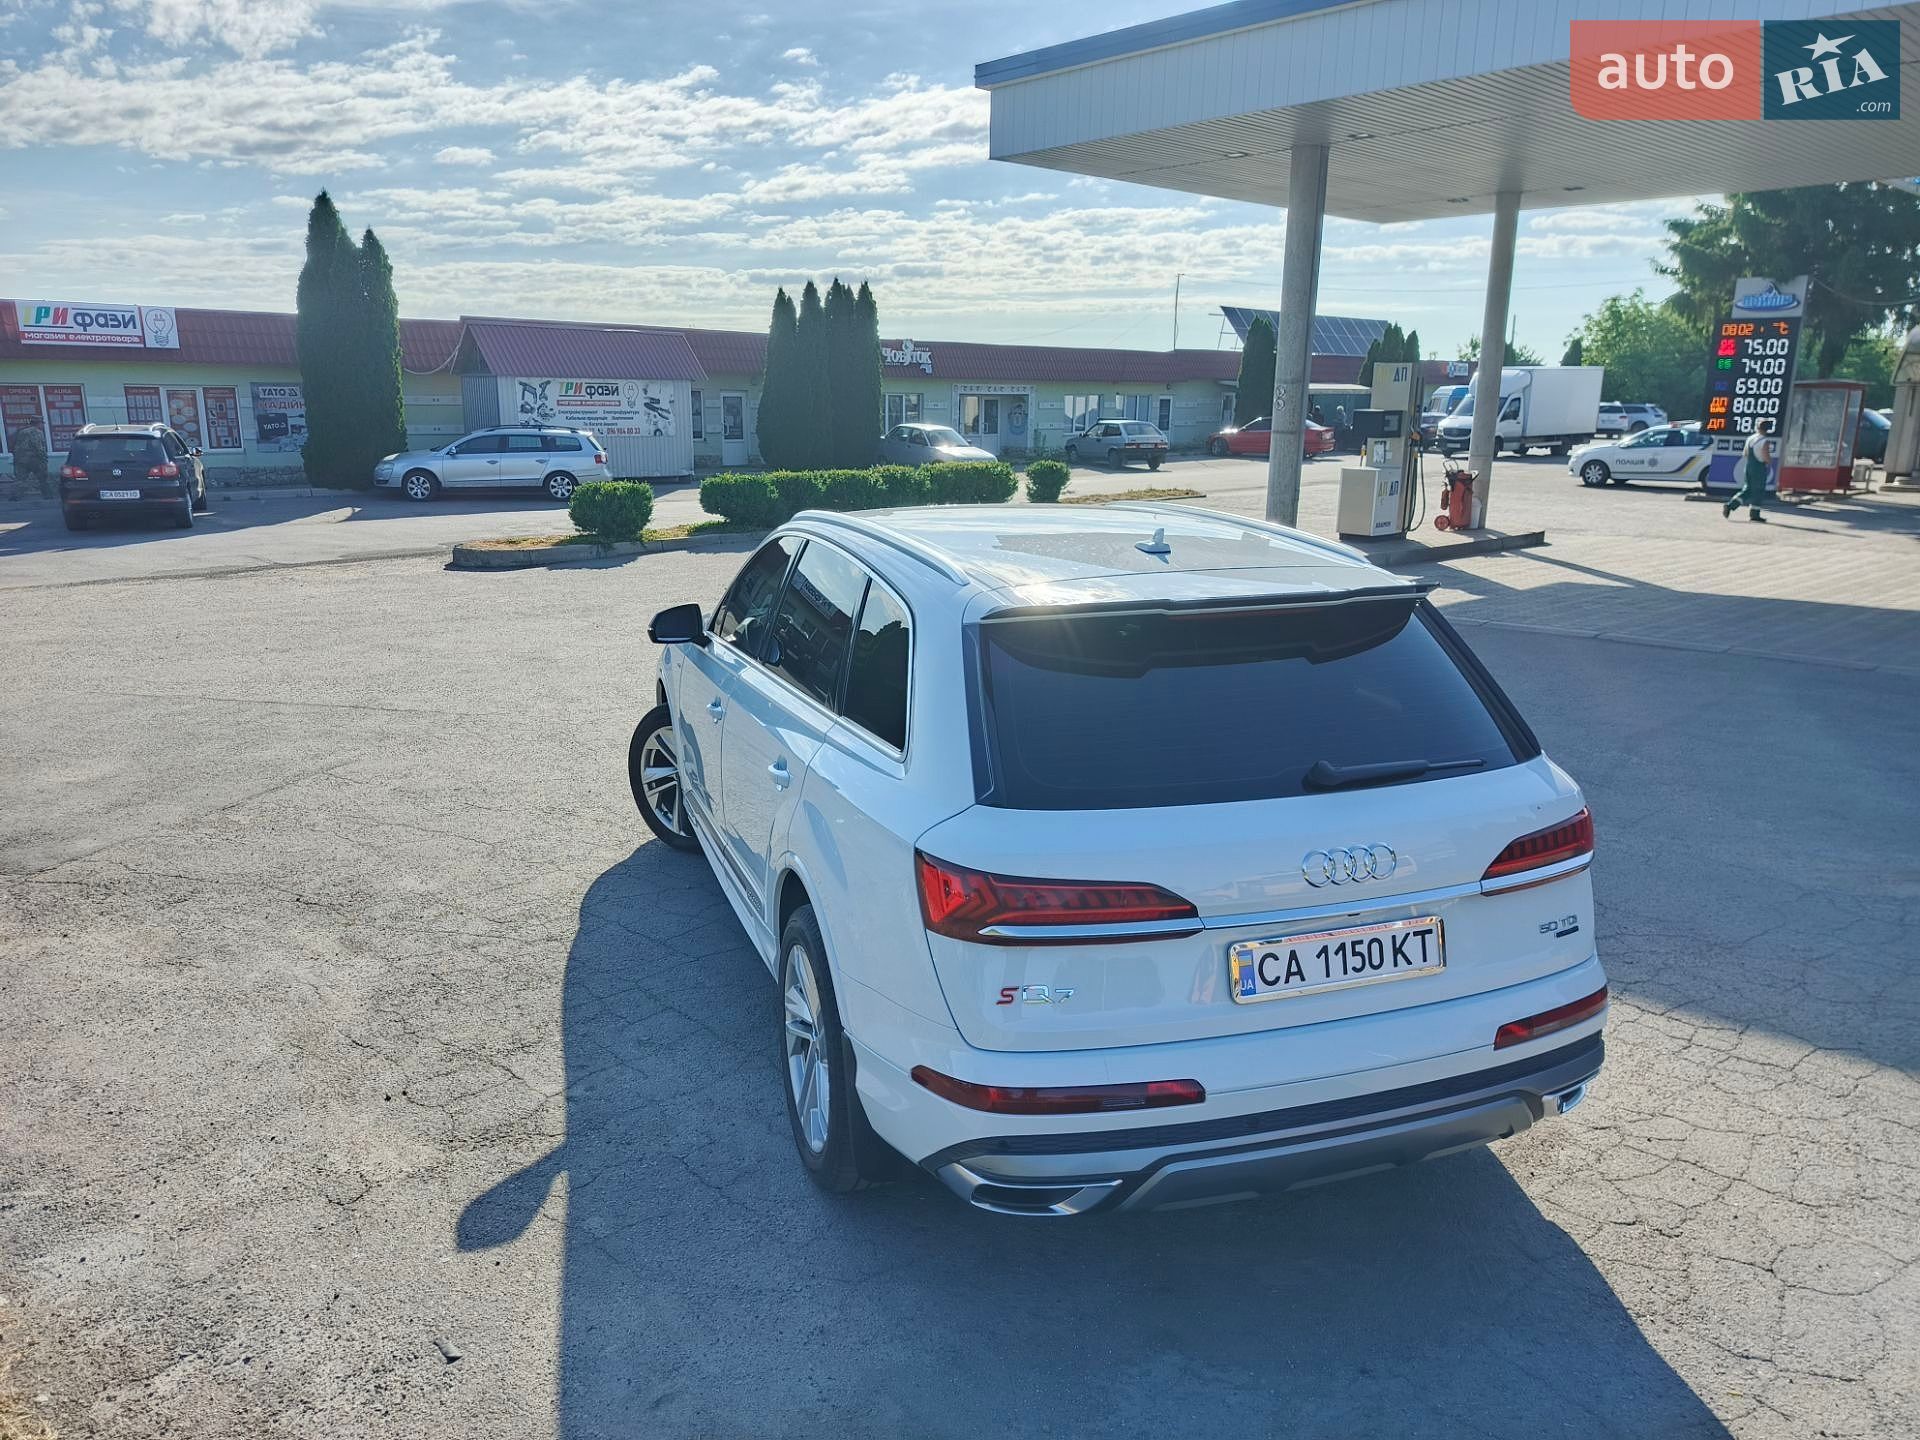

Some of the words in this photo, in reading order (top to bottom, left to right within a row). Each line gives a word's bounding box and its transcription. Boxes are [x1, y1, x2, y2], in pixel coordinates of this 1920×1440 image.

[73, 311, 137, 332] фази
[1744, 338, 1789, 356] 75.00
[1741, 358, 1786, 375] 74.00
[585, 386, 620, 399] фази
[1735, 378, 1783, 395] 69.00
[1733, 397, 1779, 414] 80.00
[1257, 949, 1306, 987] CA
[1315, 937, 1385, 979] 1150
[1391, 928, 1434, 968] KT
